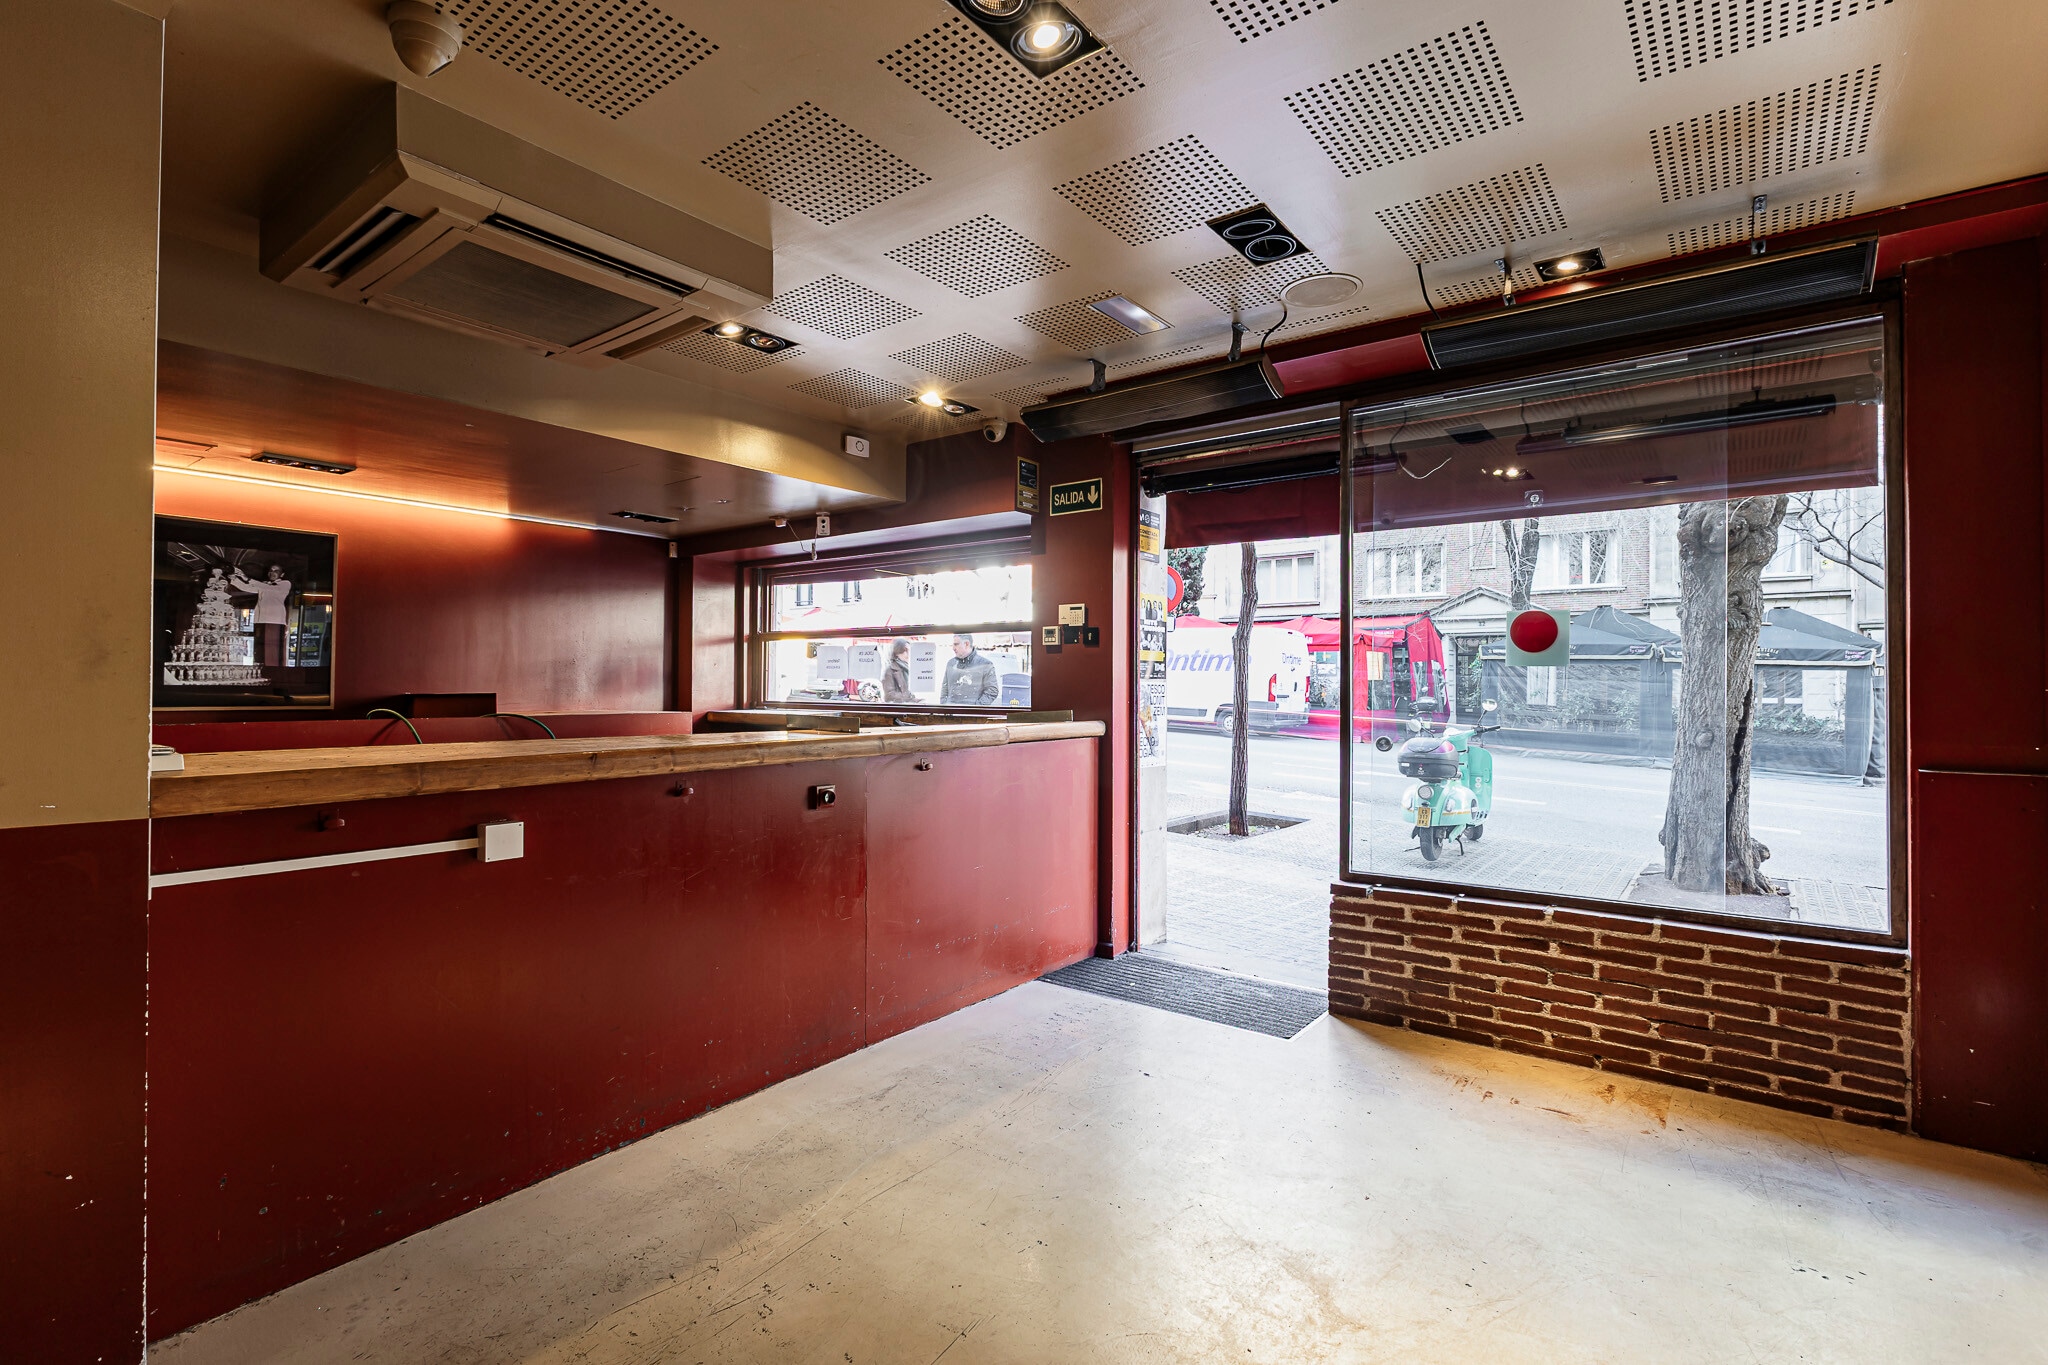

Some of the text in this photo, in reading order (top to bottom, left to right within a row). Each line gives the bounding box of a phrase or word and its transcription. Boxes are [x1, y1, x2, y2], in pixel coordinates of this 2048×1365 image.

[1054, 490, 1085, 506] SALIDA
[1167, 648, 1252, 671] ntim
[1281, 652, 1302, 666] Ontime
